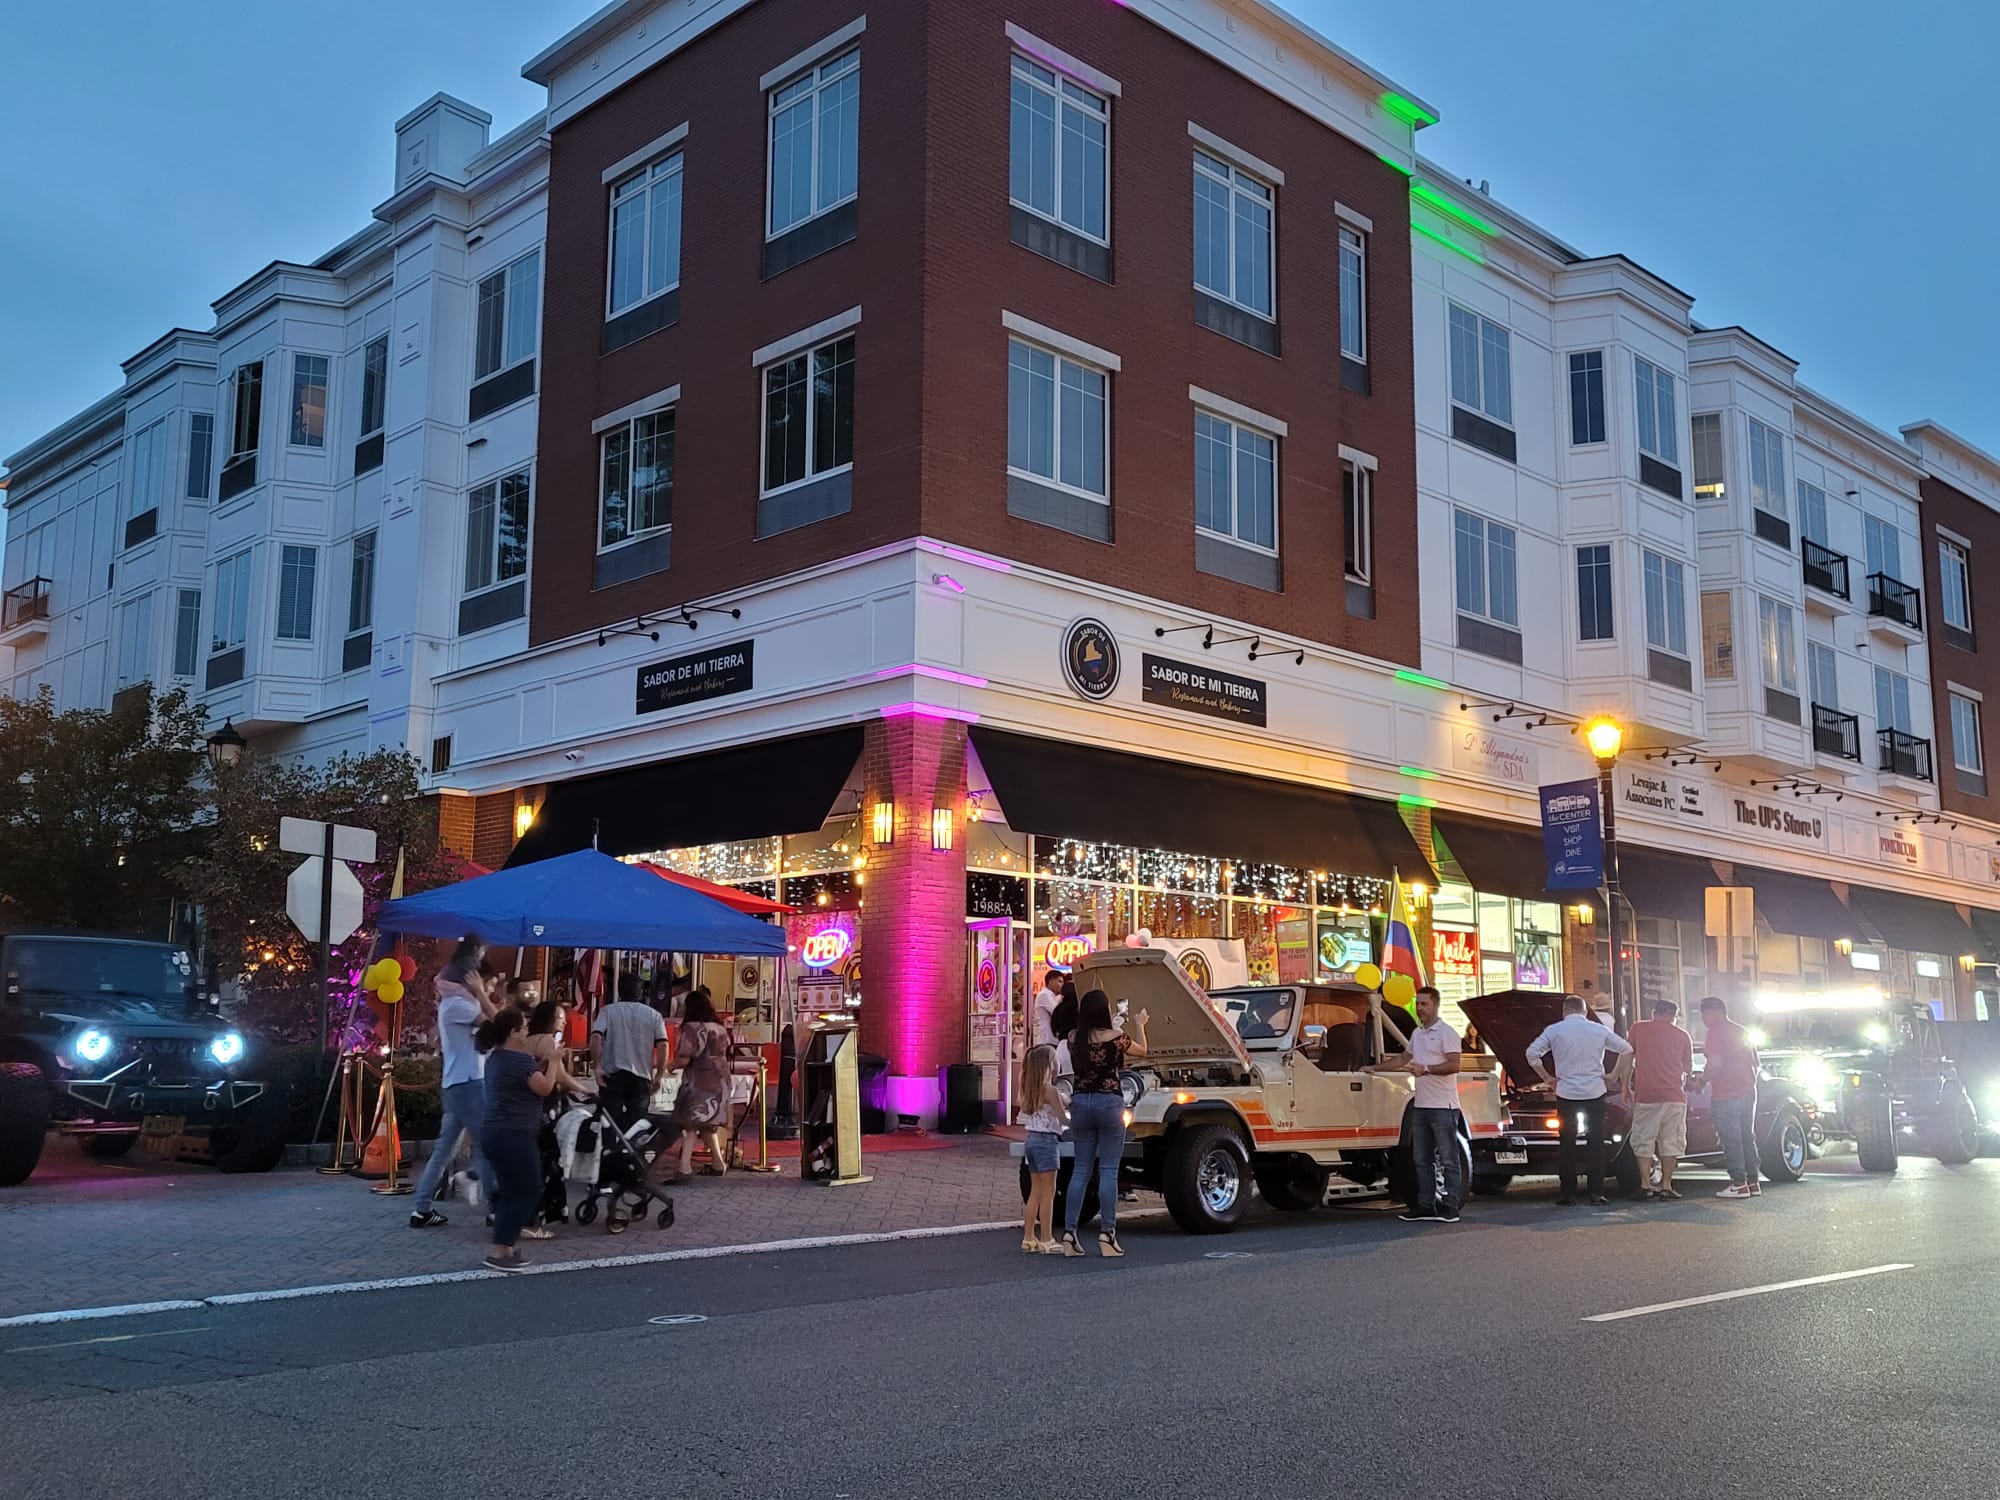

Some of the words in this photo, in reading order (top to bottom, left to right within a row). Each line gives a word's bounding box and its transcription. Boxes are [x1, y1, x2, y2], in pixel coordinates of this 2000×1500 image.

[1079, 627, 1098, 638] SABOR
[1098, 631, 1106, 642] DE
[643, 667, 676, 688] SABOR
[677, 665, 692, 680] DE
[693, 662, 706, 677] MI
[708, 652, 745, 673] TIERRA
[1078, 674, 1087, 685] MI
[1088, 681, 1108, 691] TIERRA
[1151, 665, 1189, 685] SABOR
[1191, 674, 1206, 690] DE
[1208, 678, 1221, 694] MI
[1223, 681, 1259, 702] TIERRA
[1204, 697, 1218, 707] and
[1219, 697, 1241, 715] Bakery
[1502, 760, 1525, 782] SPA
[1631, 773, 1659, 792] Levajac
[1660, 780, 1668, 793] &
[1625, 788, 1663, 808] Associates
[1664, 797, 1675, 810] PC
[1559, 809, 1591, 821] CENTER
[1734, 799, 1757, 826] The
[1758, 805, 1782, 831] UPS
[1783, 811, 1812, 838] Store
[1563, 823, 1580, 833] VISIT
[1563, 835, 1583, 847] SHOP
[1565, 847, 1582, 858] DINE
[972, 900, 1013, 915] 1988-A
[805, 933, 844, 961] OPEN
[1047, 940, 1089, 964] OPEN
[1432, 931, 1475, 963] Nails
[1276, 1119, 1294, 1129] Jeep
